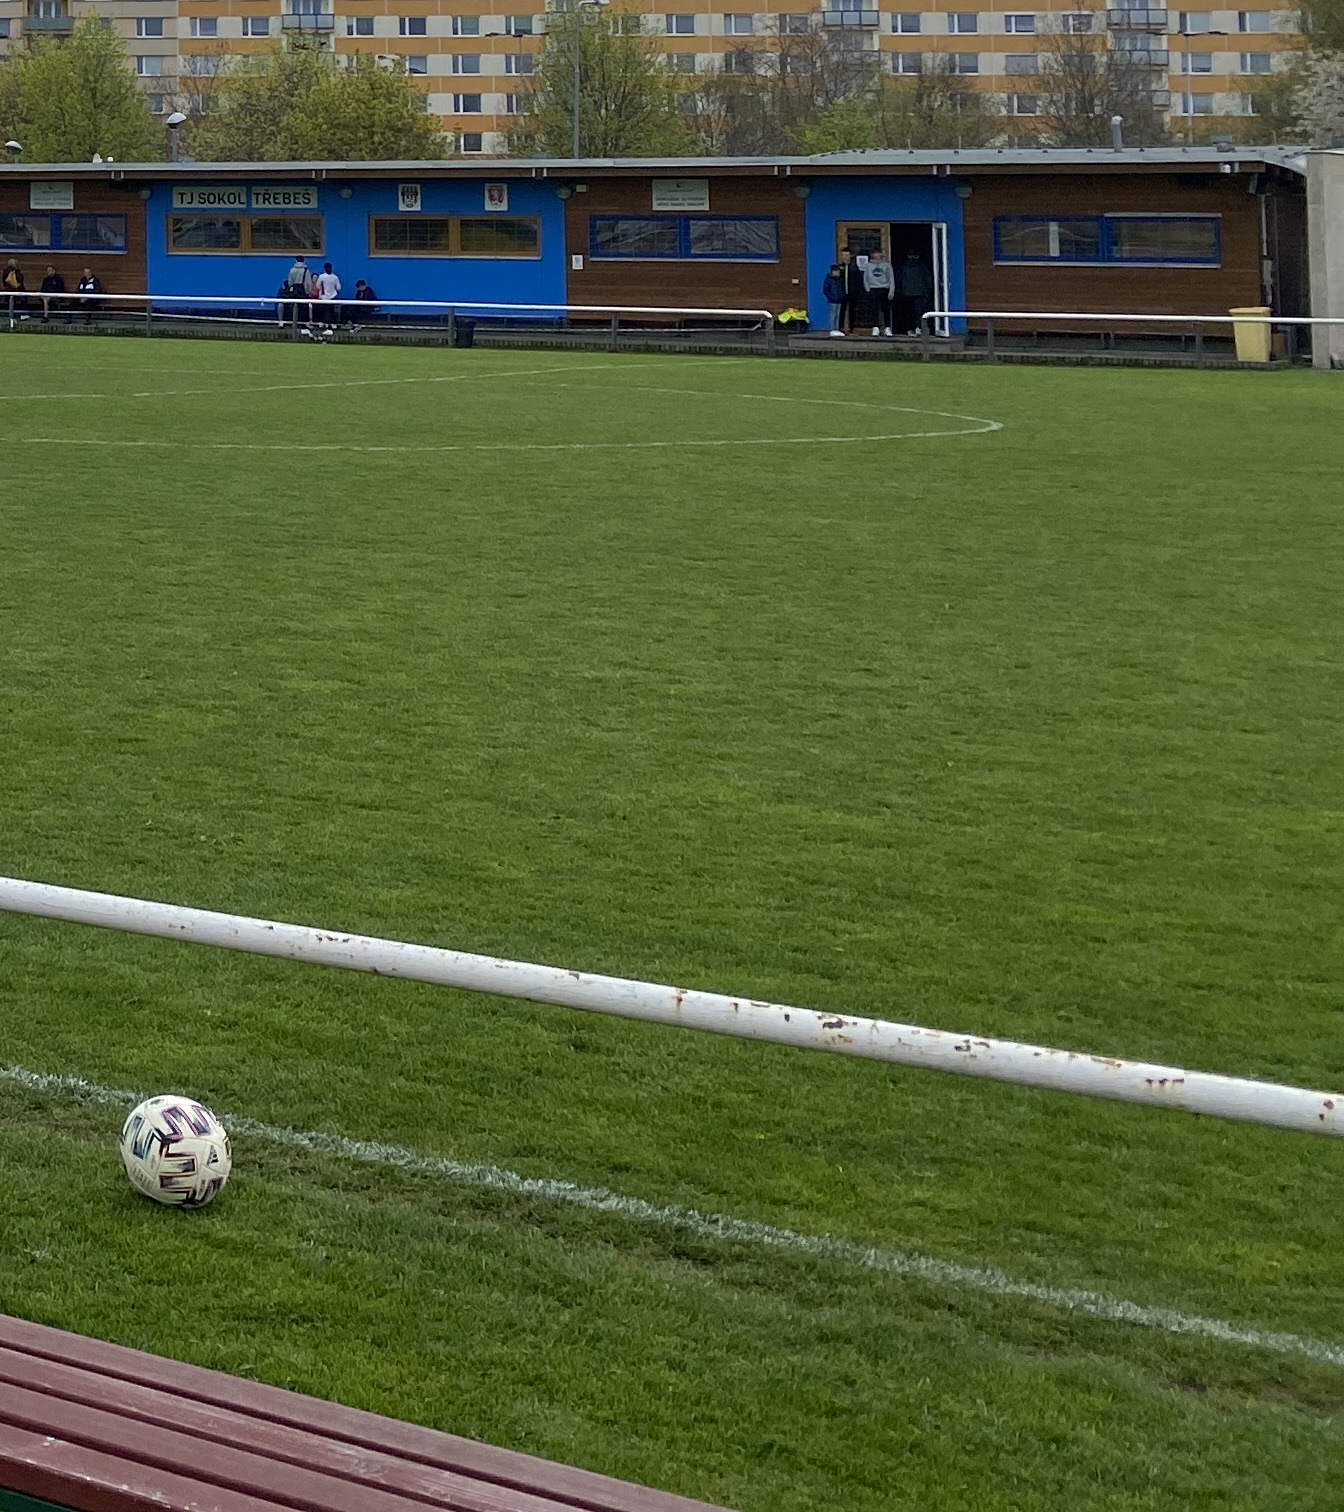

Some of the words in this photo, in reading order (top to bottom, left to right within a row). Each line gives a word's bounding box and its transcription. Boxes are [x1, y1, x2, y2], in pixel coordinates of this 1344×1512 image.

[177, 192, 194, 205] TJ
[198, 192, 246, 205] SOKOL
[253, 189, 311, 205] TŘEBEŠ
